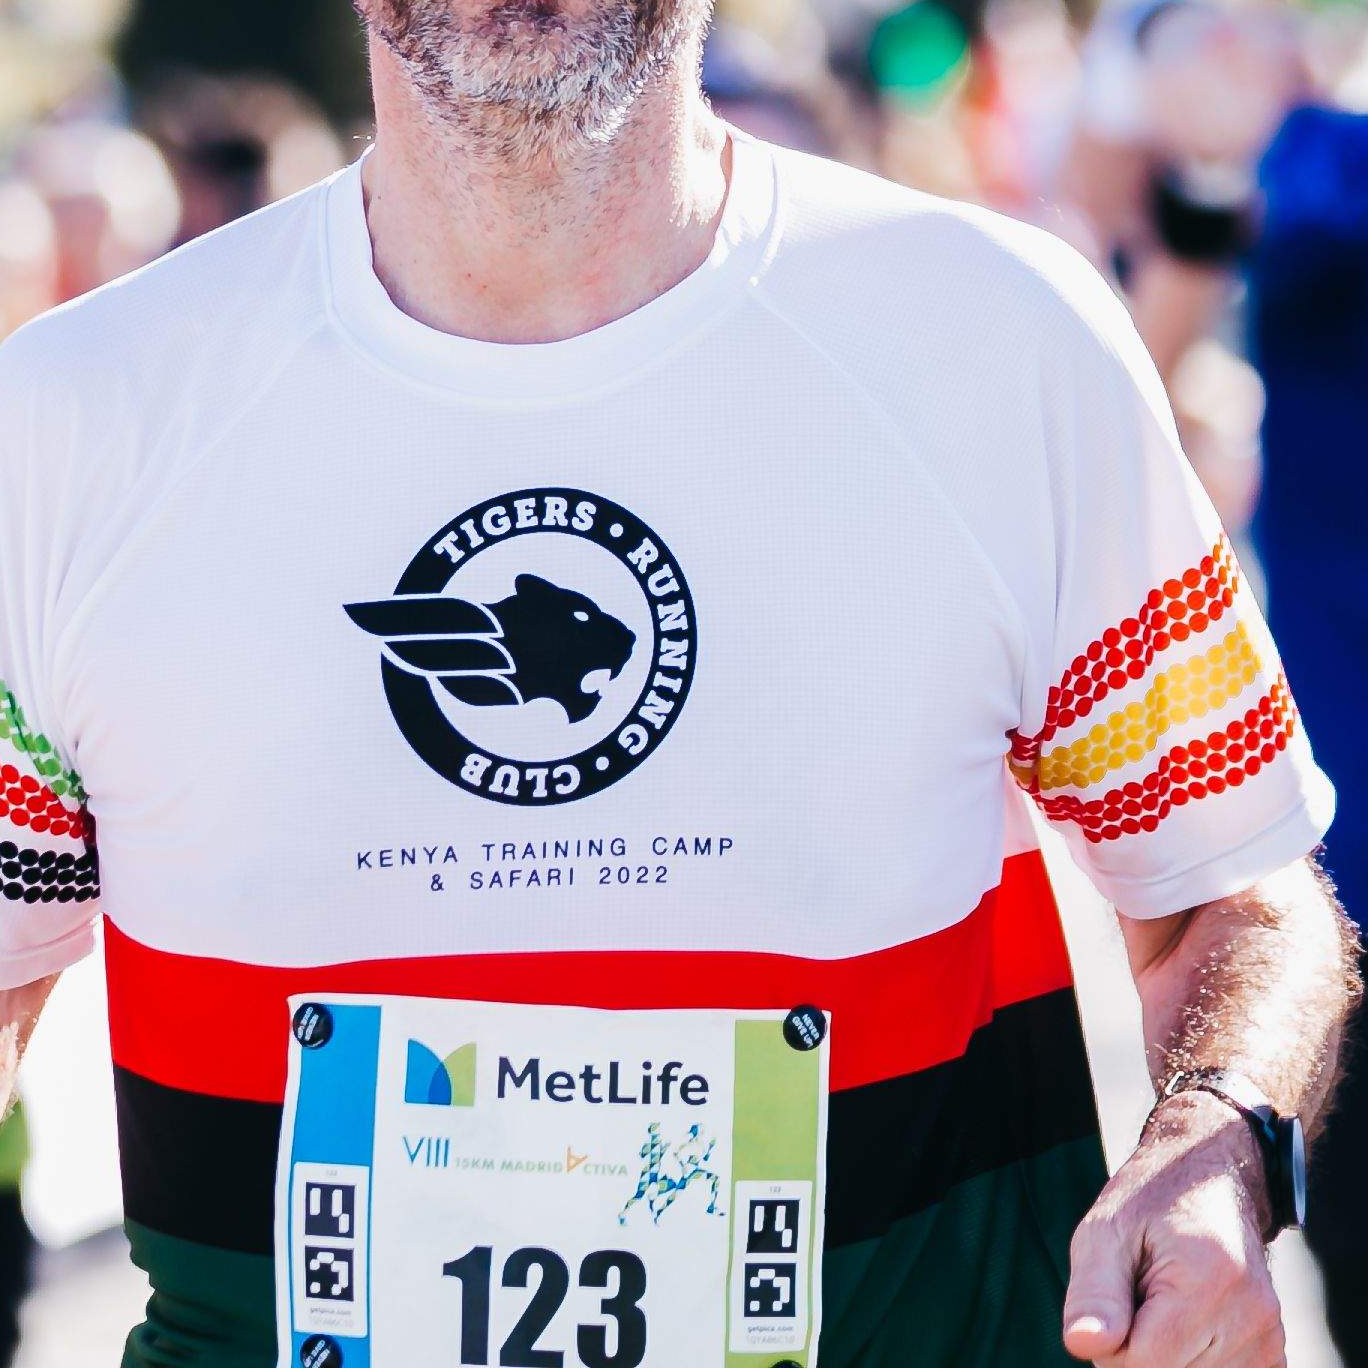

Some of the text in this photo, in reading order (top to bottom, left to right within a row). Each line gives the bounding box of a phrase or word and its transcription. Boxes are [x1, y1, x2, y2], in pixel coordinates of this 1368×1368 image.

[433, 496, 689, 798] TIGERS RUNNING CLUB
[356, 835, 735, 870] KENYA TRAINING CAMP
[430, 865, 670, 892] & SAFARI 2022
[802, 1014, 819, 1039] NEVER
[497, 1055, 711, 1107] MetLife
[402, 1135, 451, 1168] VIII
[454, 1156, 496, 1171] 15KM
[500, 1158, 564, 1175] MADRID
[441, 1243, 649, 1368] 123
